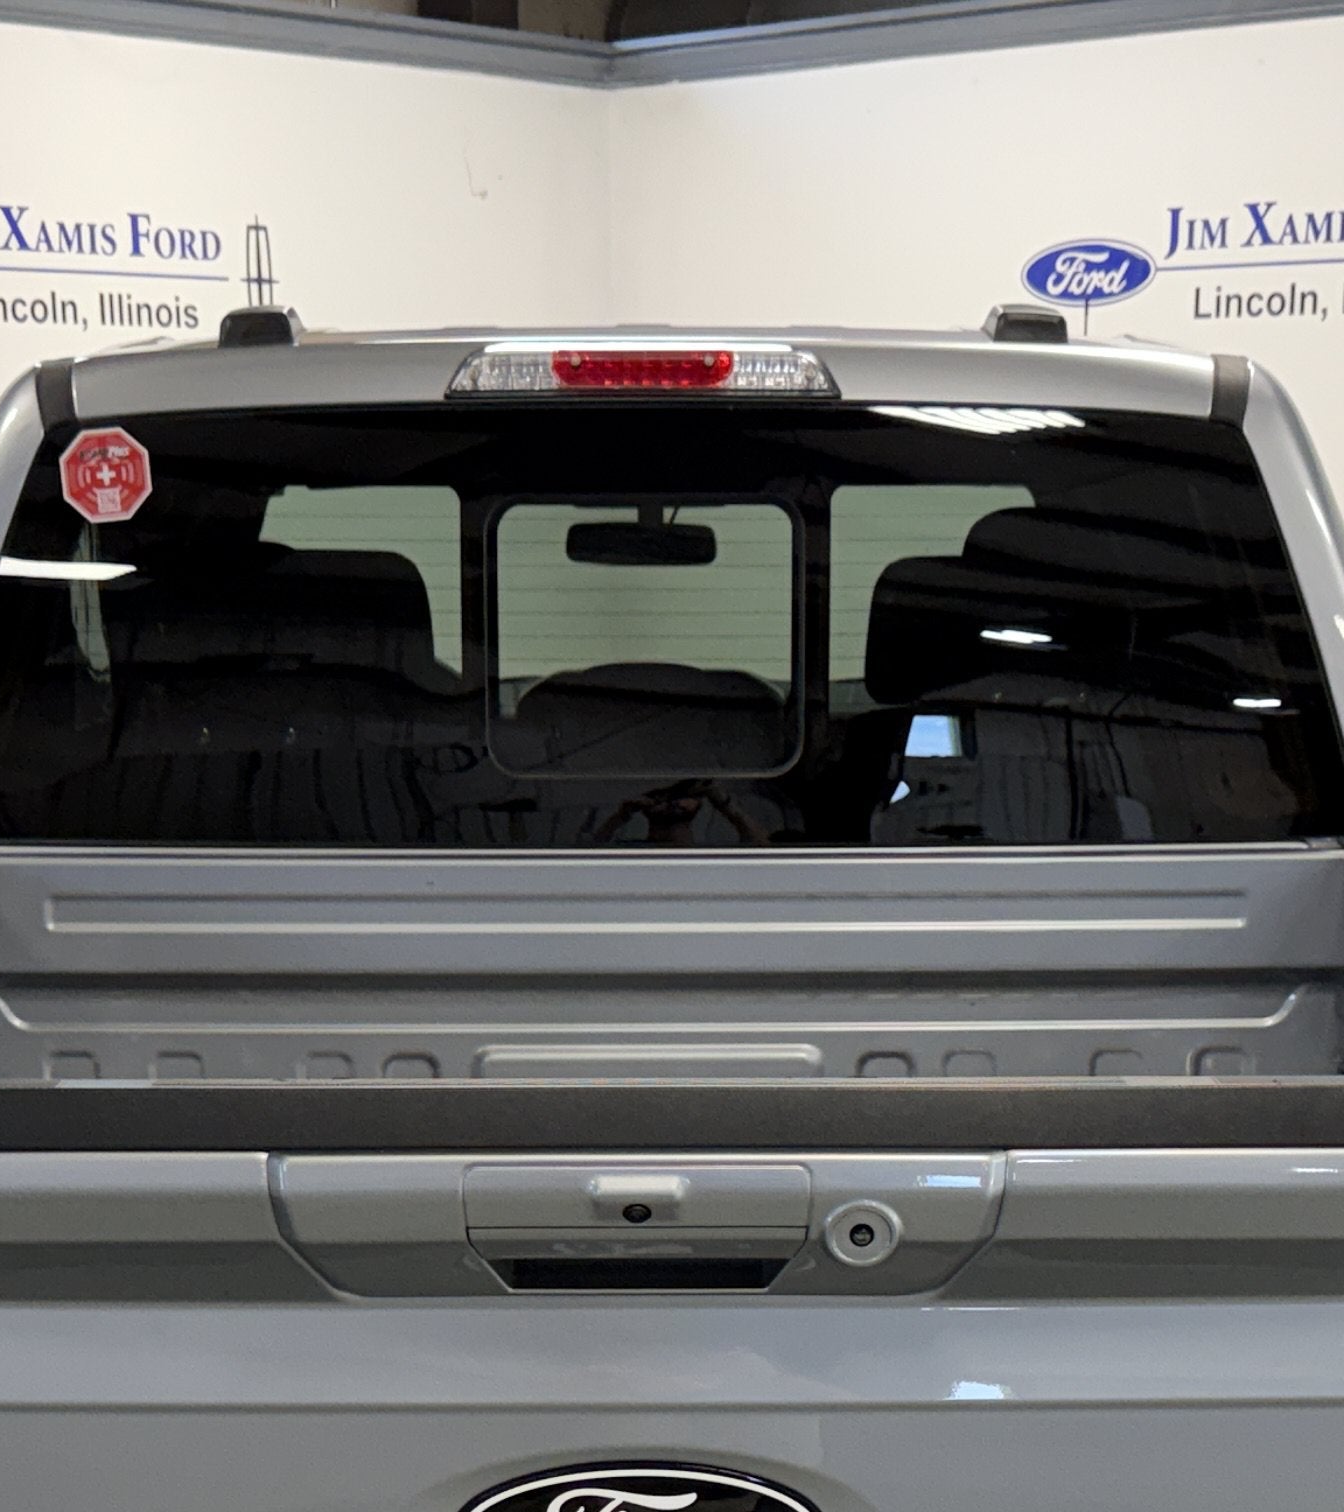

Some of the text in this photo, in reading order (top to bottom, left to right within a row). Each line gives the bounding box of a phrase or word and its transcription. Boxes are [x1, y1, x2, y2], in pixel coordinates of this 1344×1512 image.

[127, 213, 221, 261] FORD
[1165, 207, 1228, 259] JIM
[1046, 251, 1130, 295] Ford
[99, 292, 199, 329] Illinois
[1193, 283, 1327, 321] Lincoln,
